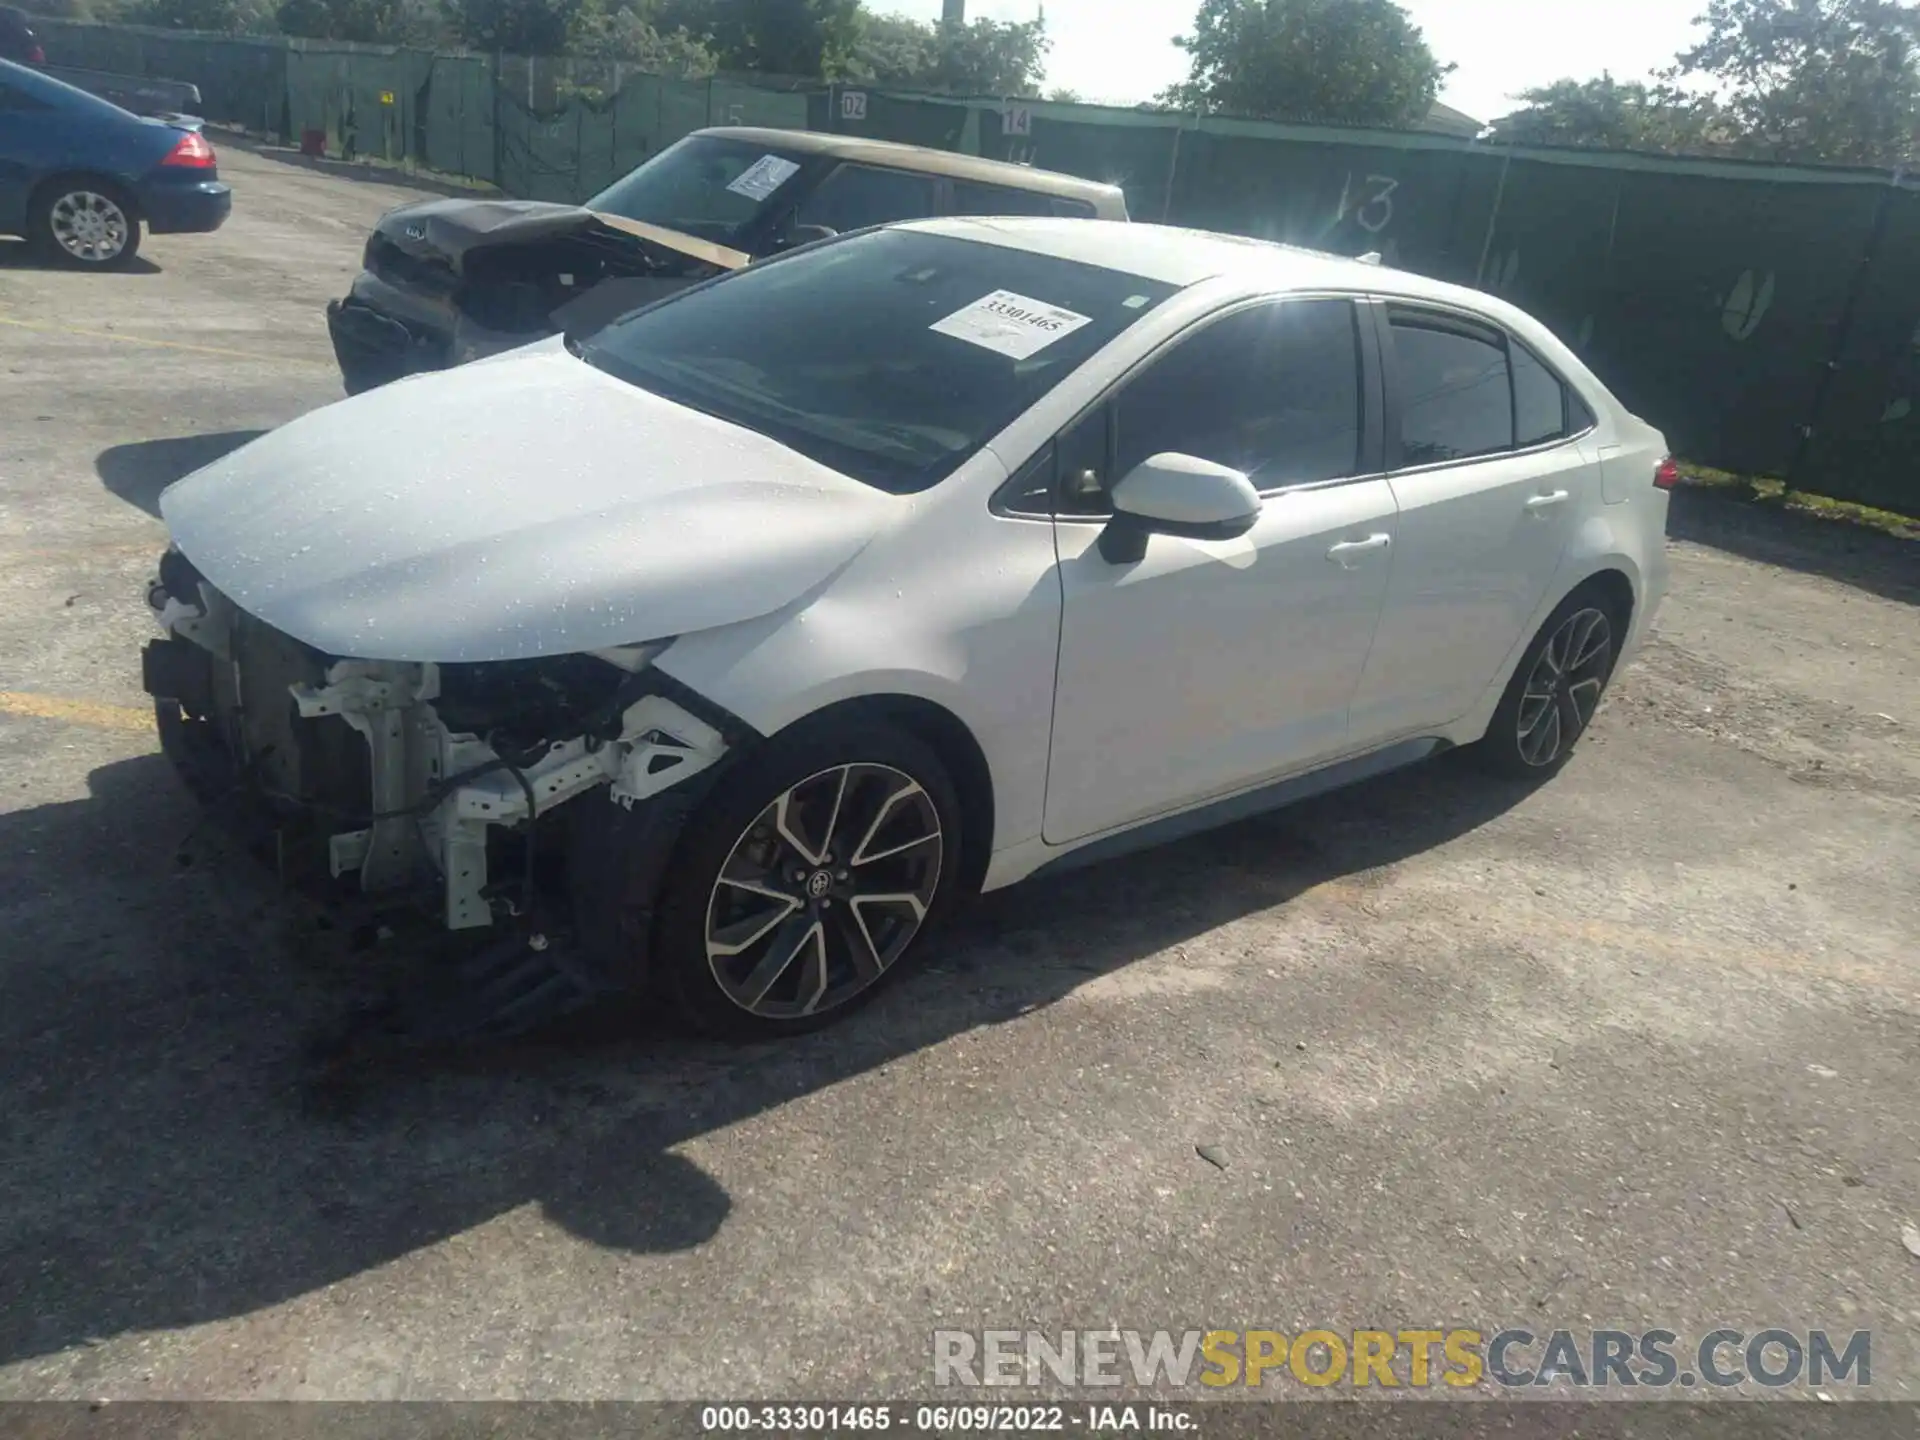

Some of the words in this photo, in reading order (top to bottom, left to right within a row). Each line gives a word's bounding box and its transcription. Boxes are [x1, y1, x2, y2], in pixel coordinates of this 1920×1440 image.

[1005, 107, 1027, 132] 14
[1336, 169, 1400, 233] 13
[981, 301, 1063, 332] 33301465
